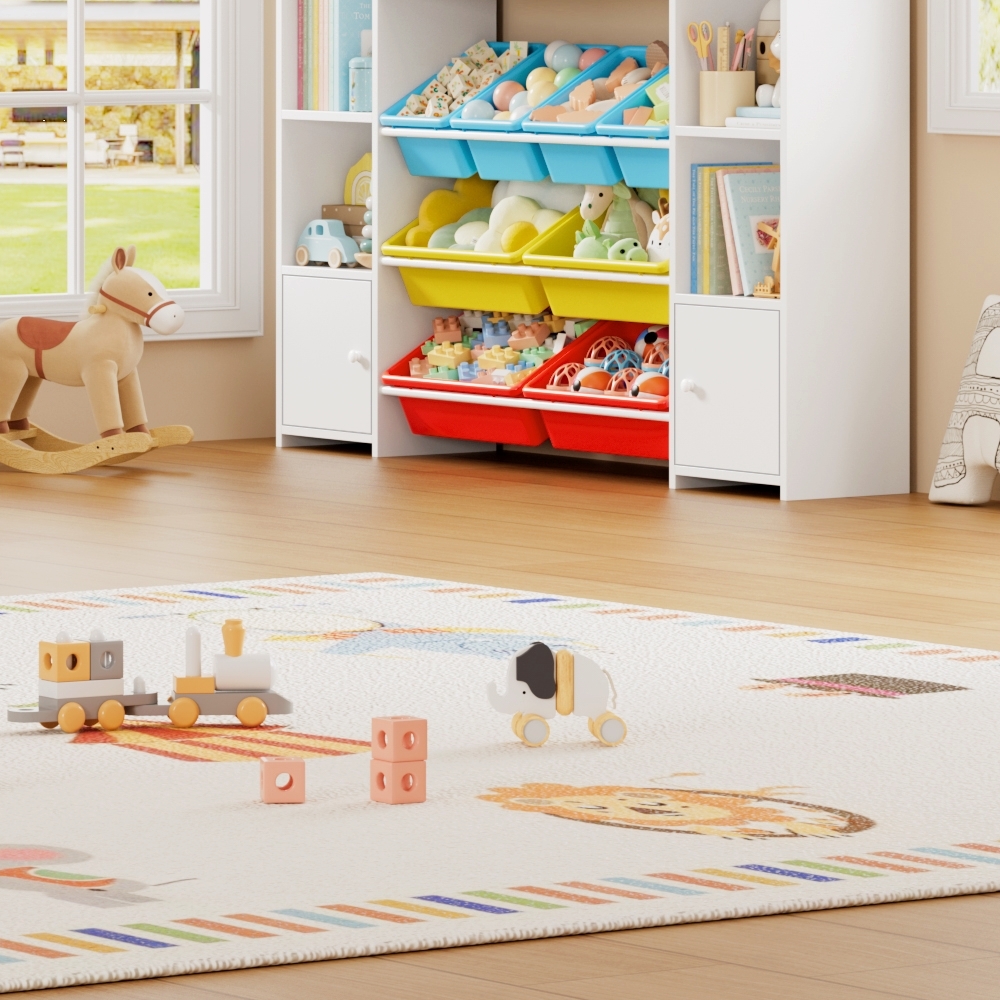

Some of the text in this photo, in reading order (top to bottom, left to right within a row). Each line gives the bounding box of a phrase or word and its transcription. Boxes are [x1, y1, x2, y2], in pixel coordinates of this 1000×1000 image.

[354, 11, 370, 20] TOM
[739, 185, 761, 193] CECILY
[740, 195, 780, 203] NURSERY RH
